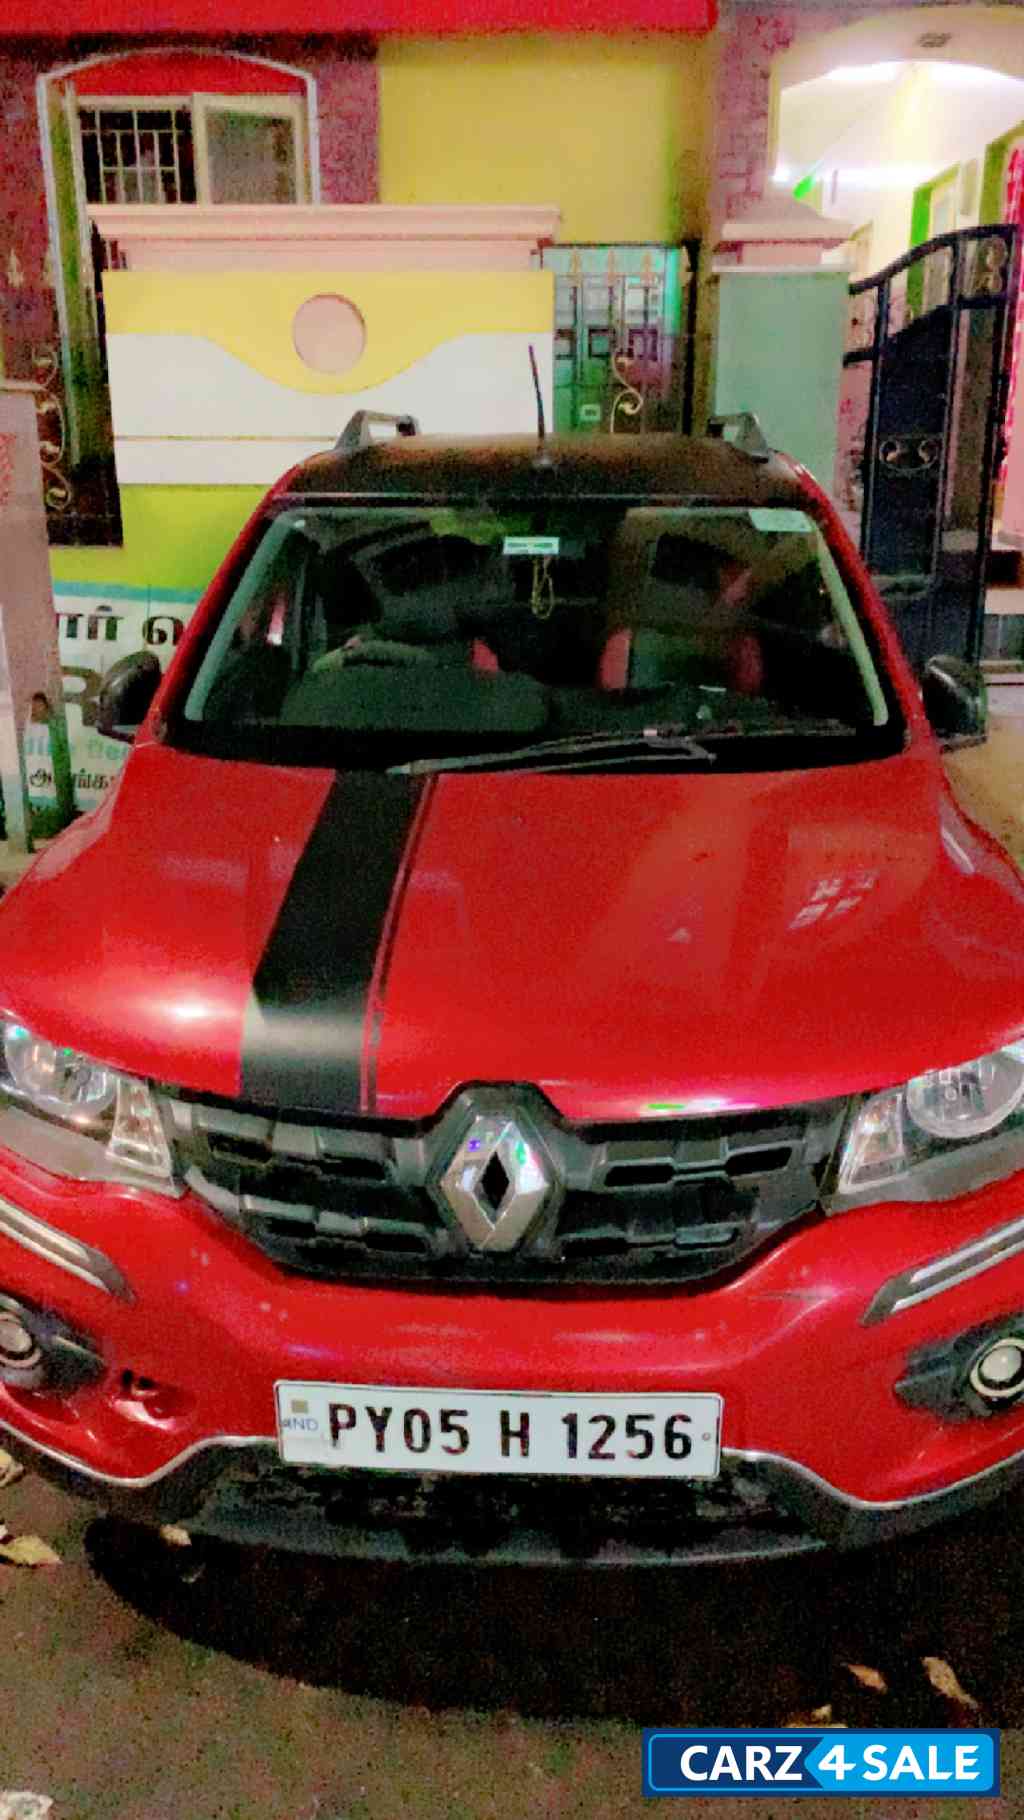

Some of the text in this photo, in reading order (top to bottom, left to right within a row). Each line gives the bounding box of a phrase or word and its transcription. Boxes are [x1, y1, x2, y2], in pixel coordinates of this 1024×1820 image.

[328, 1403, 693, 1459] PY05 H 1256
